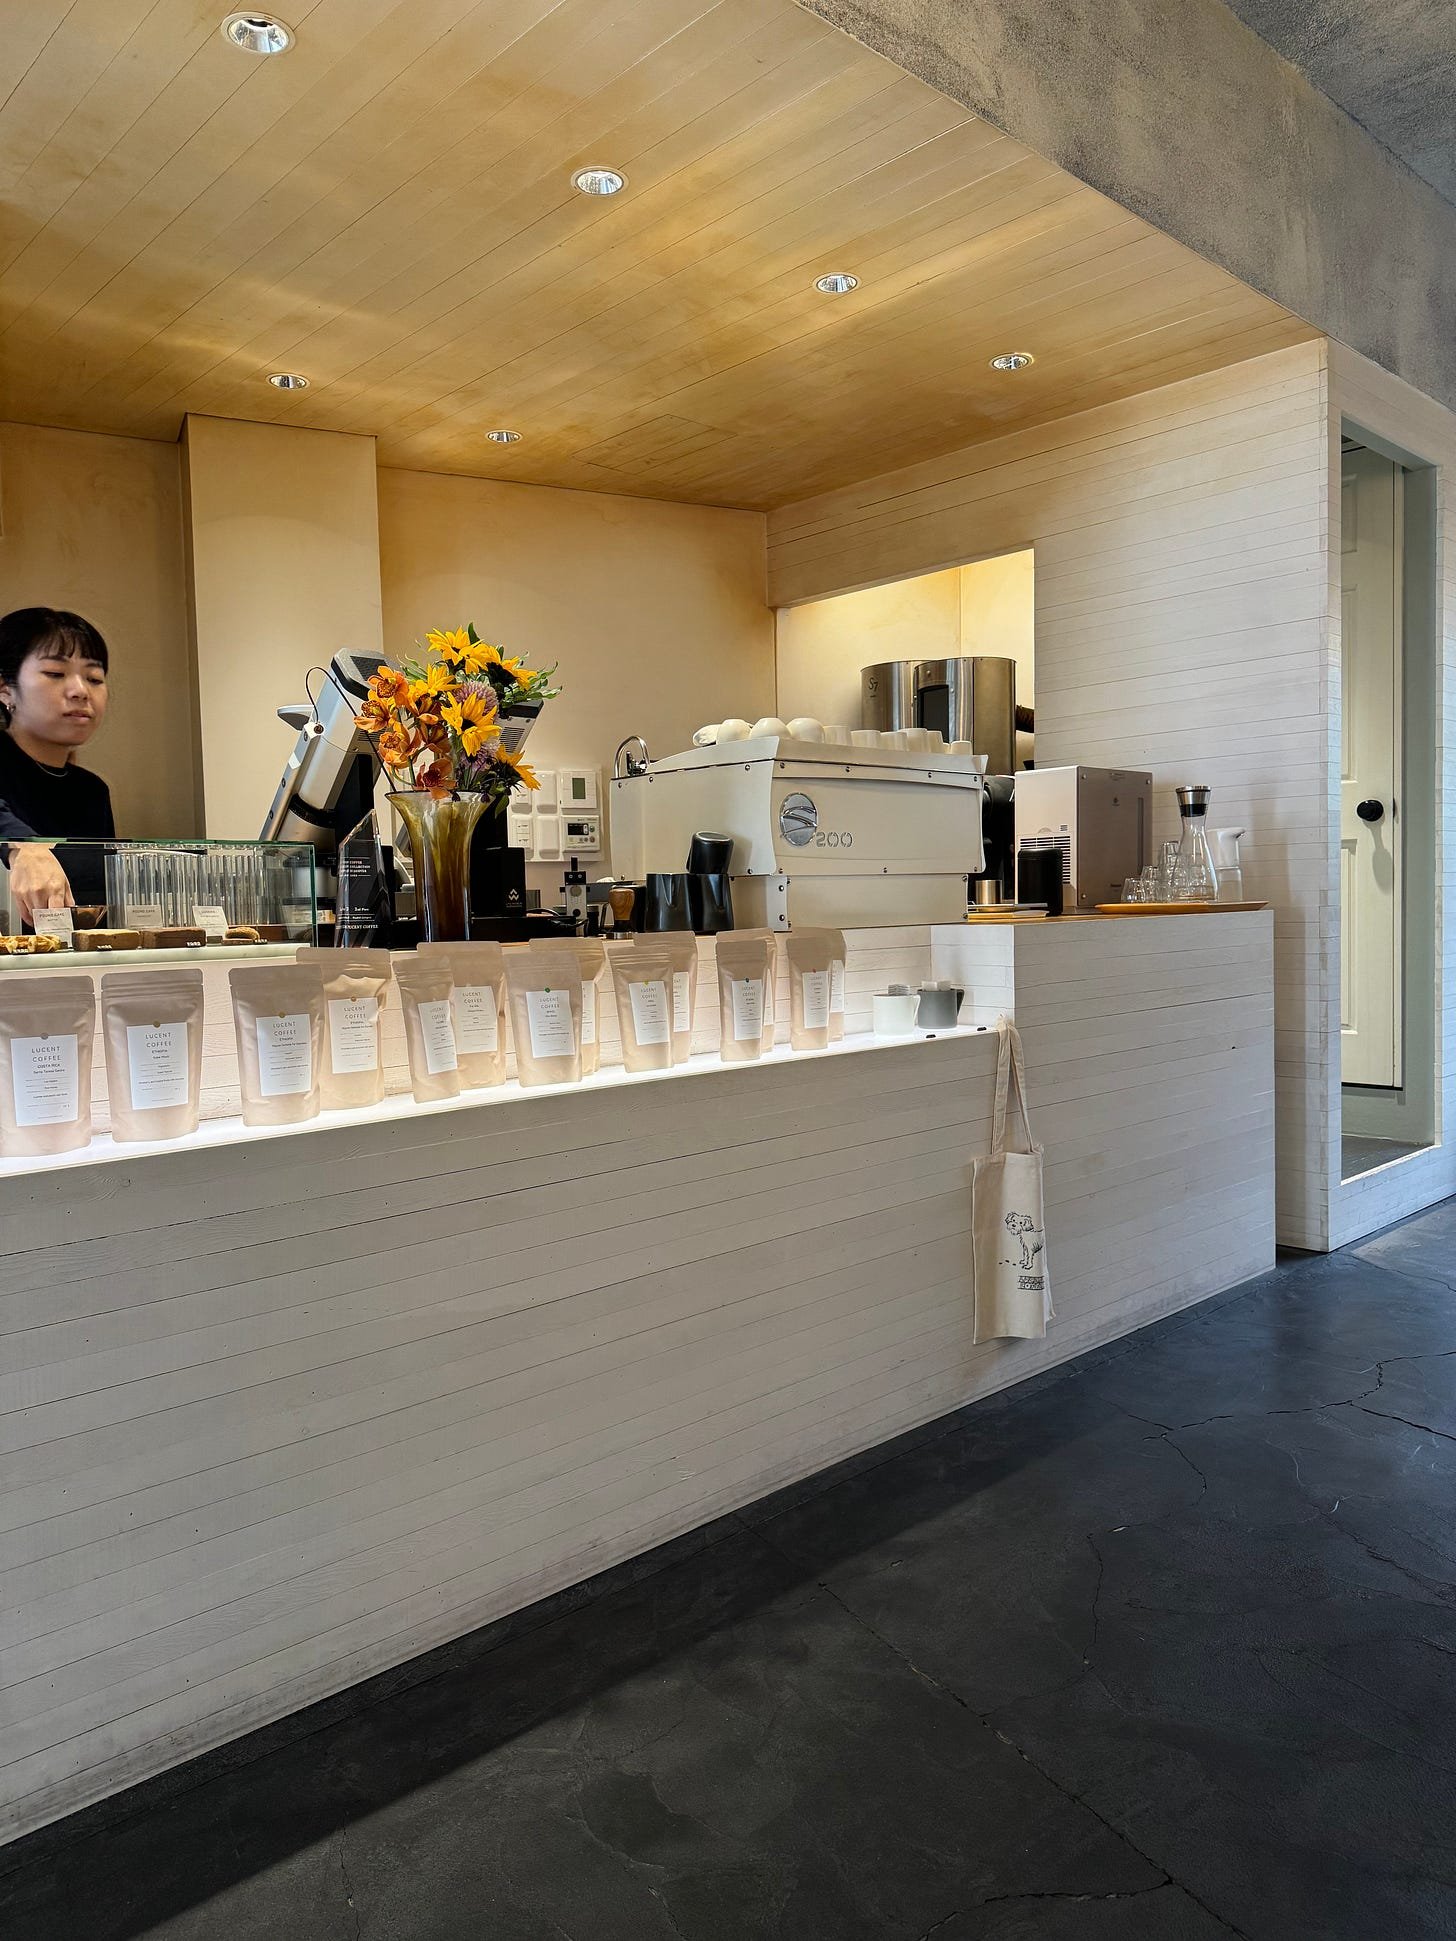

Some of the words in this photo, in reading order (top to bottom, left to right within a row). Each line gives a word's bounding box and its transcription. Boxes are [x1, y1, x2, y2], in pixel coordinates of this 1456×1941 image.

[868, 677, 879, 692] S7
[816, 831, 853, 848] 200
[31, 1046, 61, 1054] LUCENT
